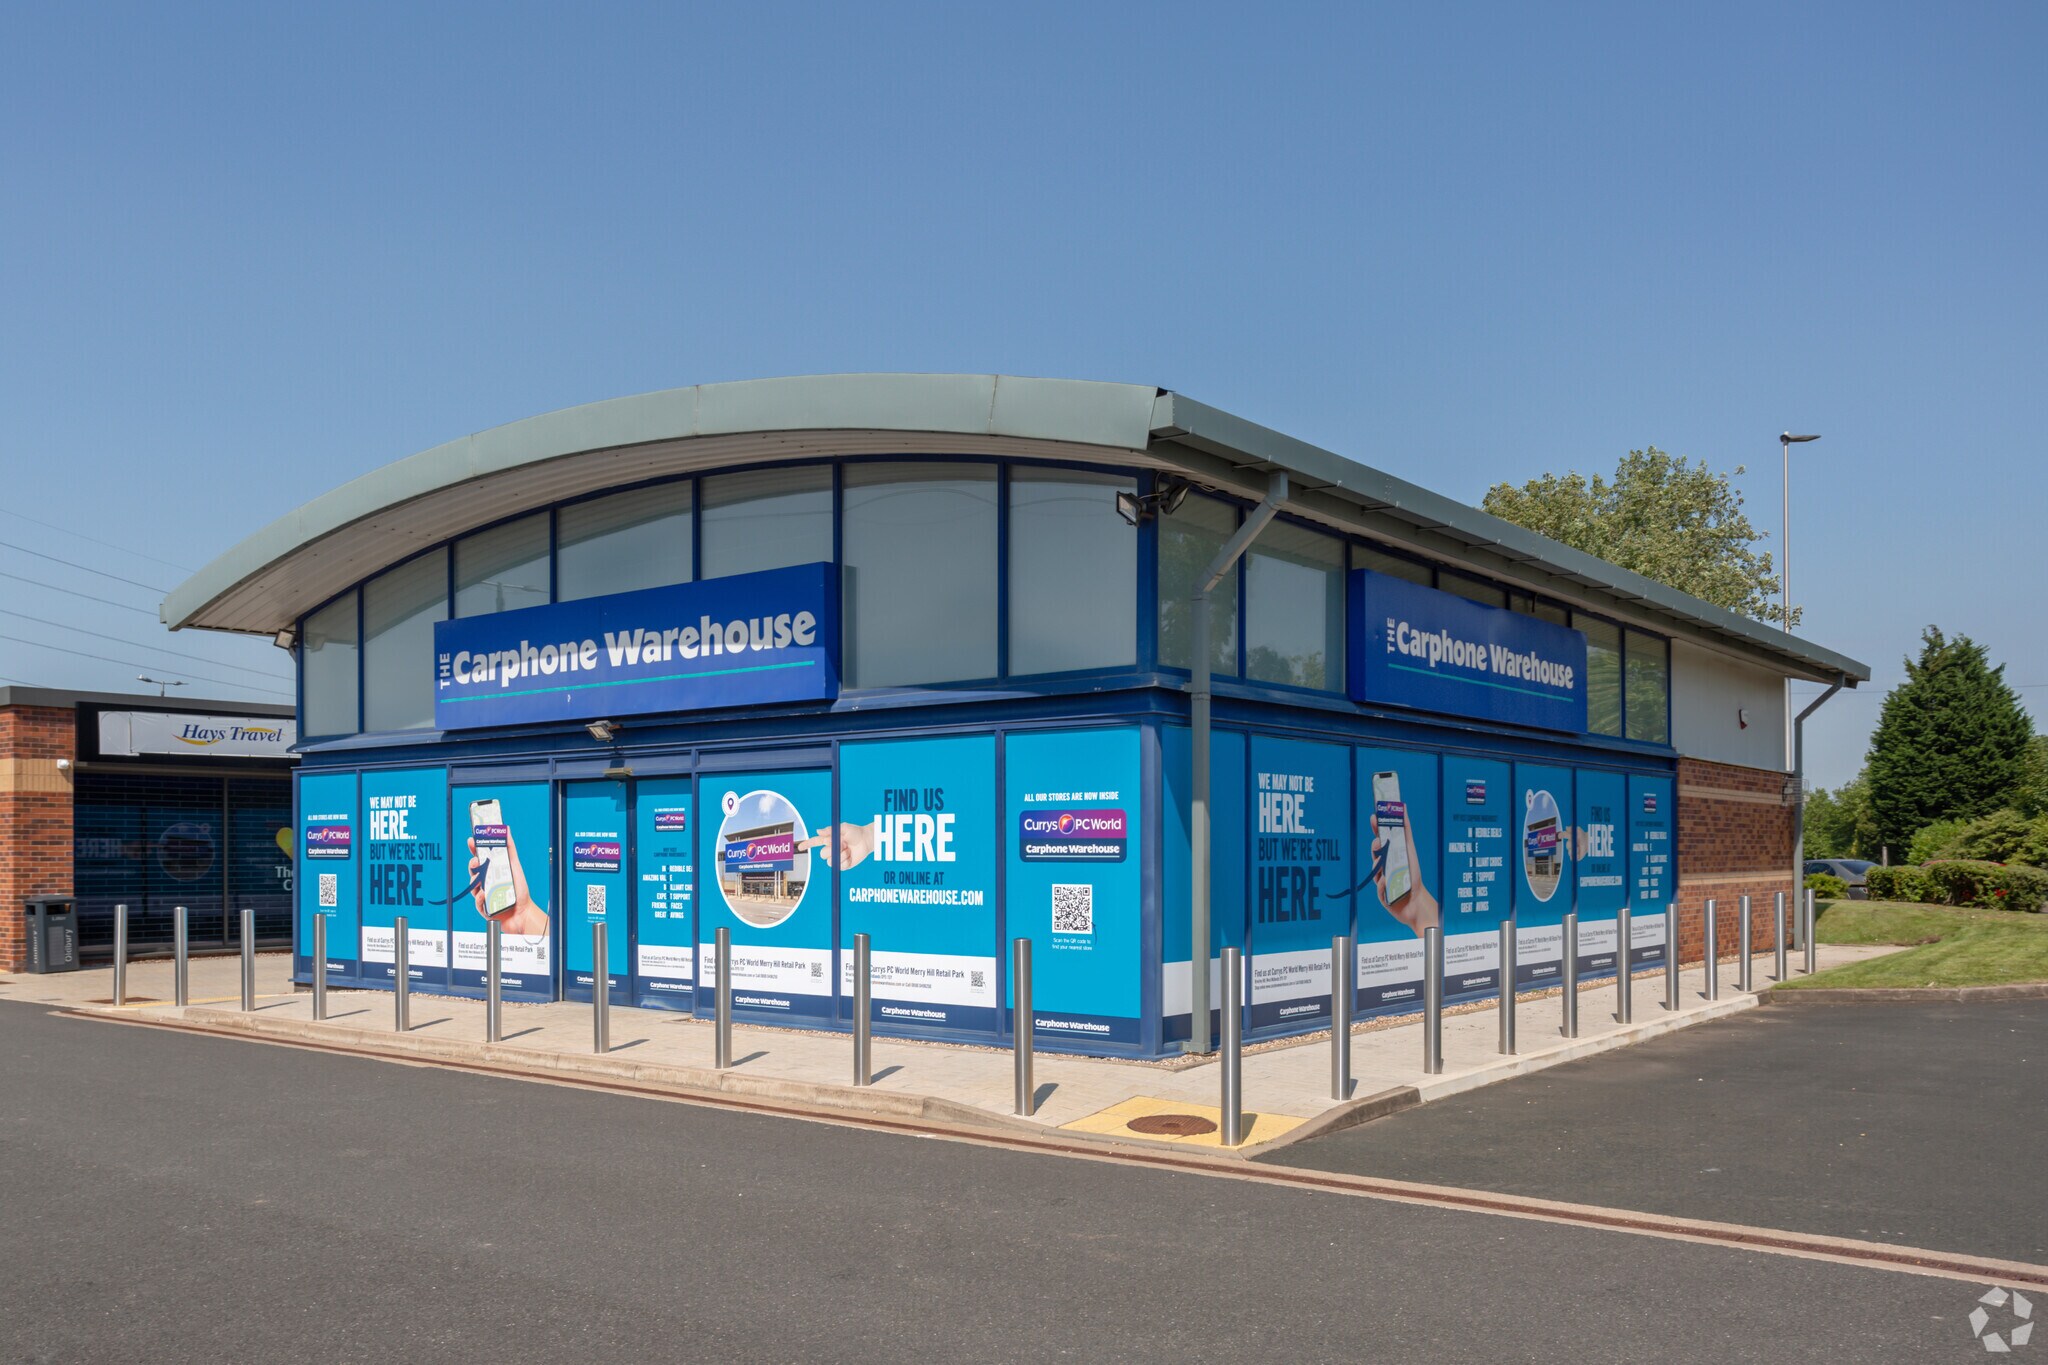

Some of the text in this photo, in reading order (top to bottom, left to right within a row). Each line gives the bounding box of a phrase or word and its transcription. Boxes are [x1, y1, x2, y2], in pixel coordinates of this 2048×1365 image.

[440, 610, 816, 690] THE Carphone Warehouse
[1387, 617, 1574, 690] THE Carphone Warehouse
[182, 724, 282, 743] Hays Travel
[1258, 772, 1314, 792] WE MAY NOT BE
[370, 795, 416, 808] WE MAY NOT BE
[884, 788, 944, 812] FIND US
[1024, 791, 1119, 802] ALL OUR STORES ARE NOW INSIDE
[1258, 792, 1315, 834] HERE...
[370, 810, 418, 840] HERE...
[1024, 818, 1122, 832] Currys PC World
[308, 831, 322, 841] Currys
[874, 814, 956, 862] HERE
[1588, 824, 1614, 857] HERE
[370, 843, 442, 861] BUT WE'RE STILL
[575, 846, 591, 856] Currys
[727, 843, 790, 859] Currys PC World
[1026, 844, 1120, 855] Carphone Warehouse
[1258, 838, 1340, 861] BUT WE'RE STILL
[370, 864, 424, 906] HERE
[884, 871, 944, 885] OR ONLINE AT
[850, 888, 984, 906] CARPHONEWAREHOUSE.COM
[1258, 866, 1322, 924] HERE
[65, 929, 73, 962] Oldbury
[760, 960, 773, 968] Merry
[895, 967, 909, 975] World
[910, 967, 926, 977] Merry
[936, 969, 951, 978] Retail
[952, 970, 964, 979] Park
[735, 996, 790, 1006] Carphone Warehouse
[1280, 1005, 1298, 1015] Carphone
[882, 1006, 946, 1018] Carphone Warehouse
[1035, 1018, 1110, 1032] Carphone Warehouse
